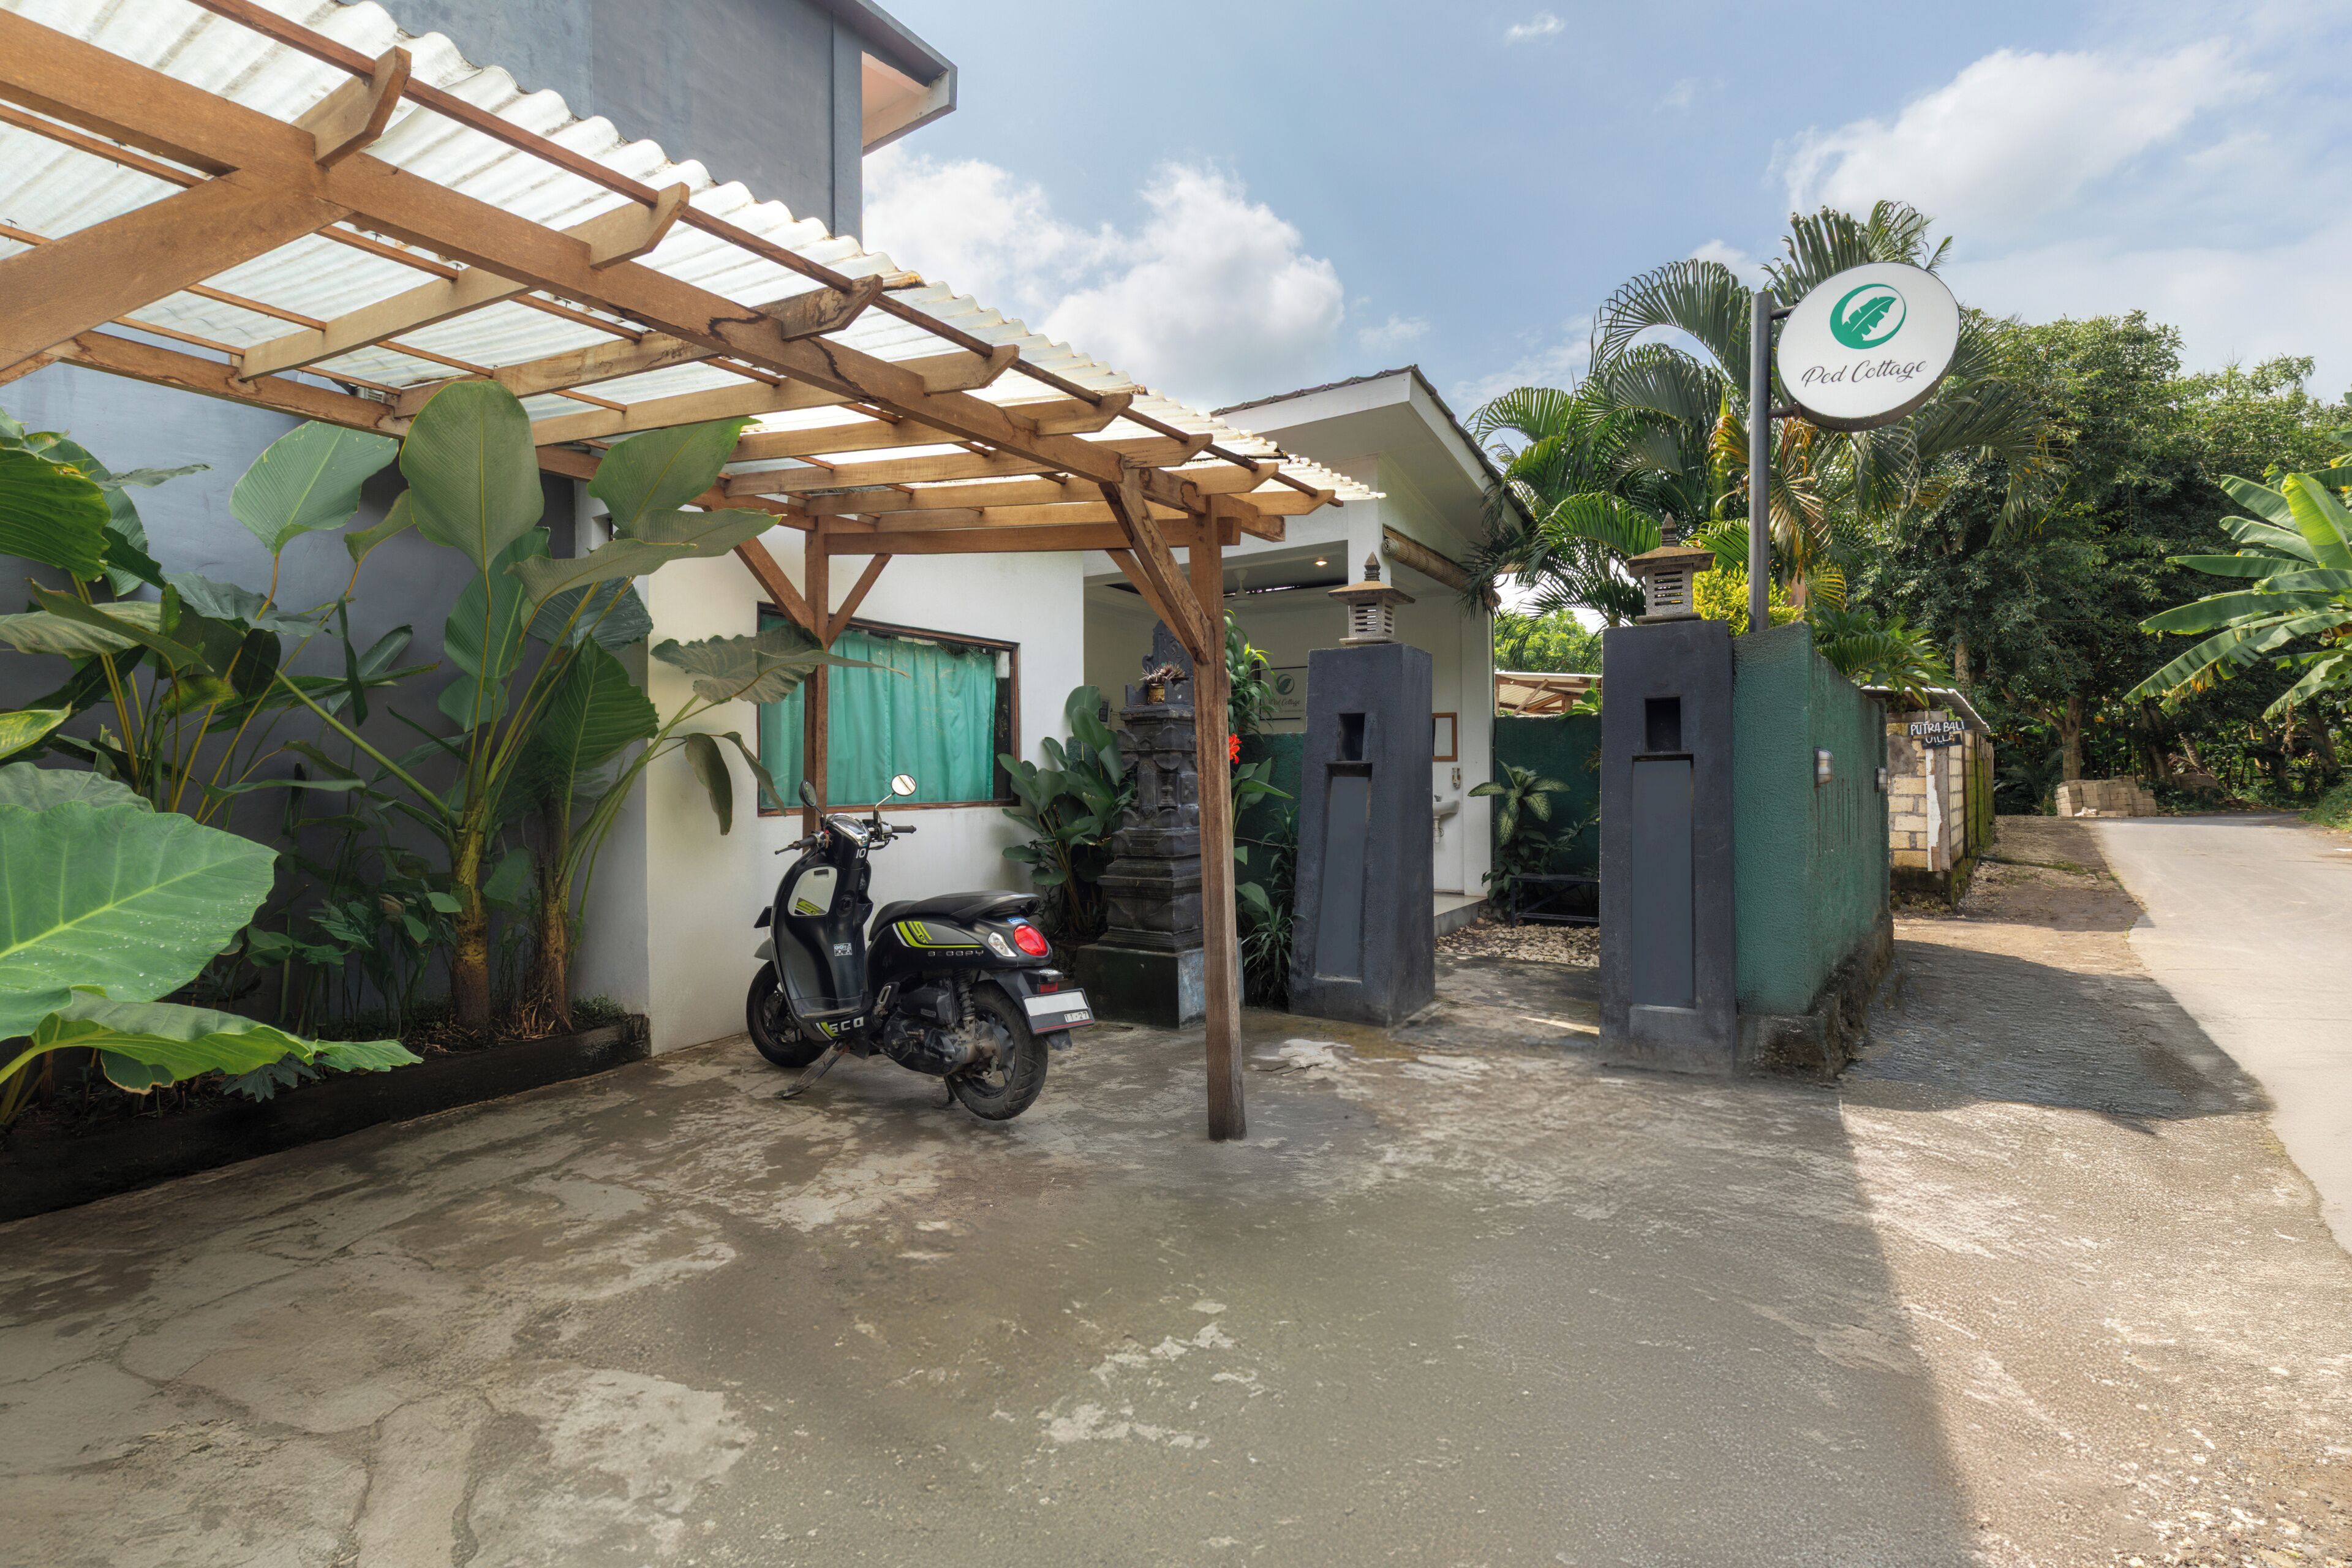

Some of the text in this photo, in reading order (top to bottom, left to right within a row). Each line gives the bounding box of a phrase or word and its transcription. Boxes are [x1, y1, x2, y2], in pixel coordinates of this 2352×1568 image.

[1801, 360, 1928, 388] Ped Cottage
[1910, 720, 1965, 736] PUTRA BALI
